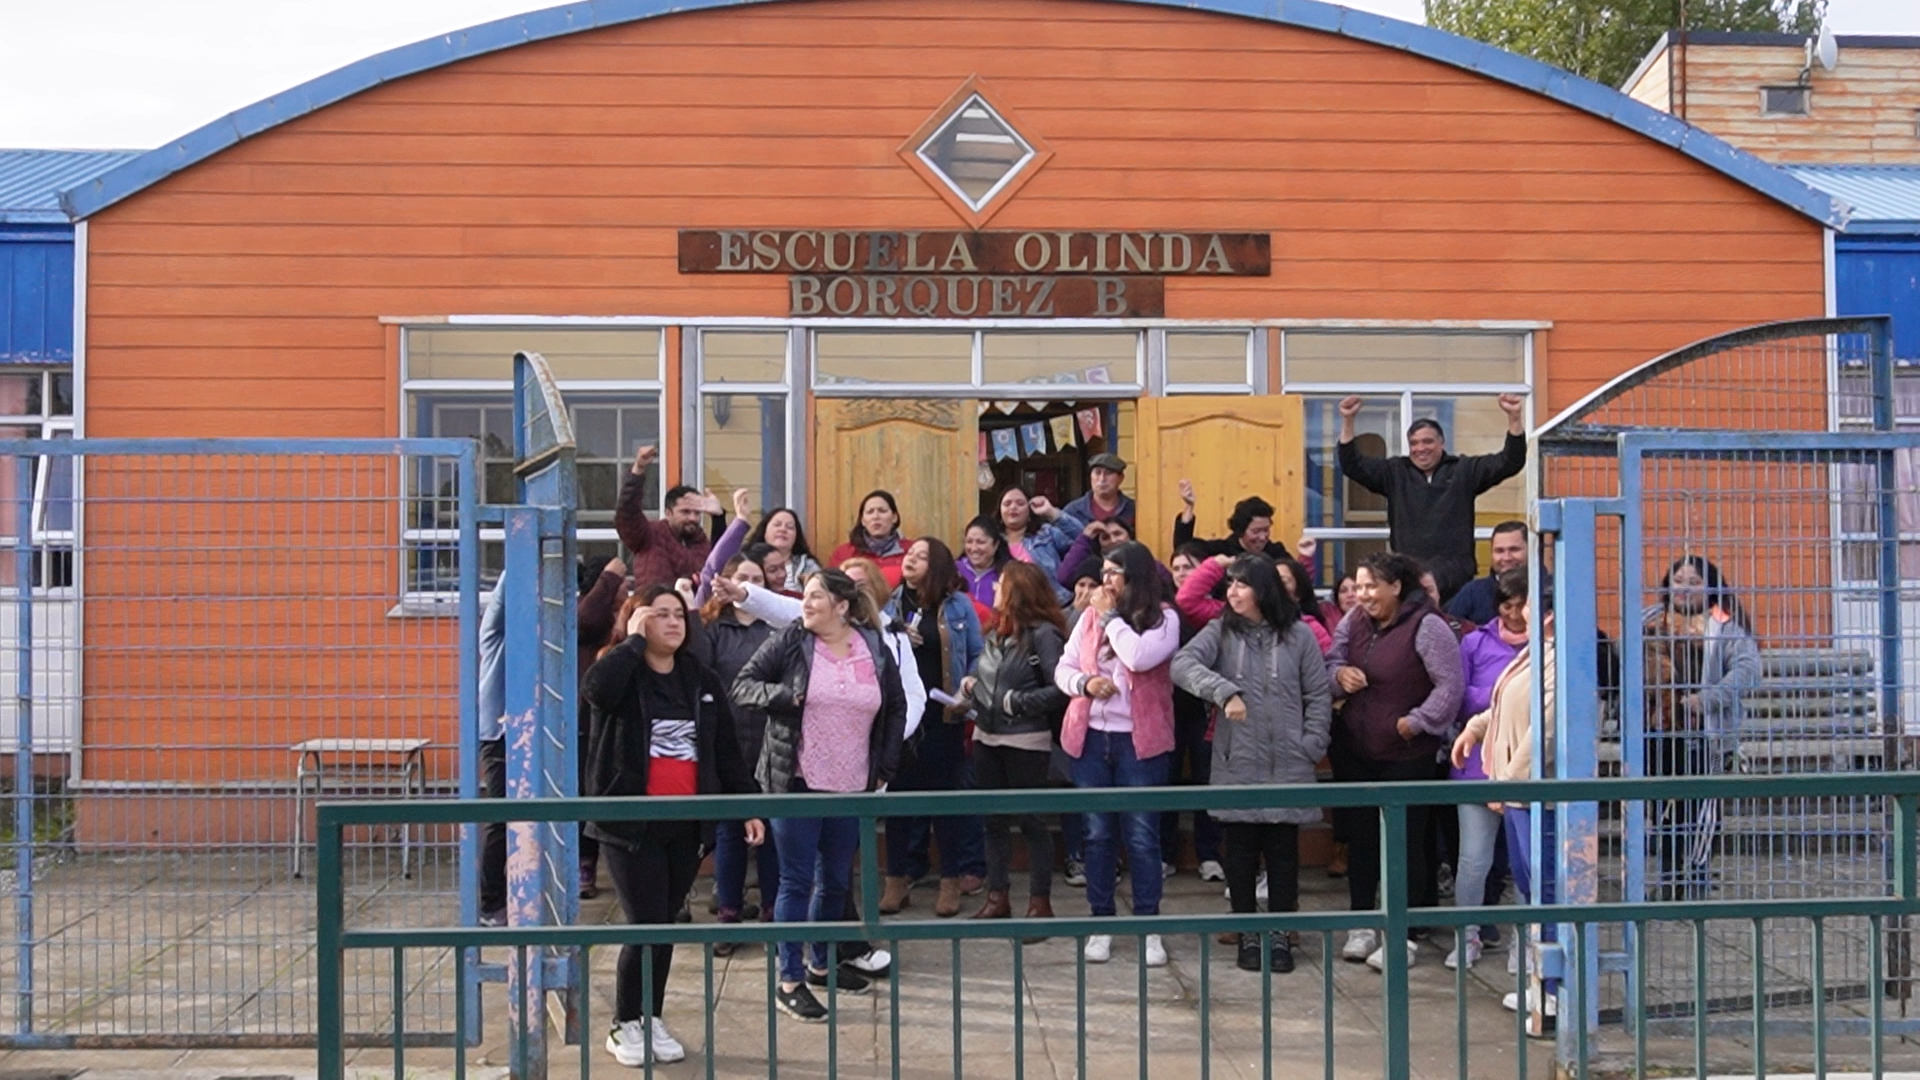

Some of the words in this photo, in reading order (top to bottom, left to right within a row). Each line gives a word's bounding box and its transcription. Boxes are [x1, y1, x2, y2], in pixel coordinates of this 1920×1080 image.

[716, 230, 977, 271] ESCUELA
[1014, 232, 1233, 272] OLINDA
[789, 275, 1055, 316] BORQUEZ
[1093, 276, 1127, 316] B
